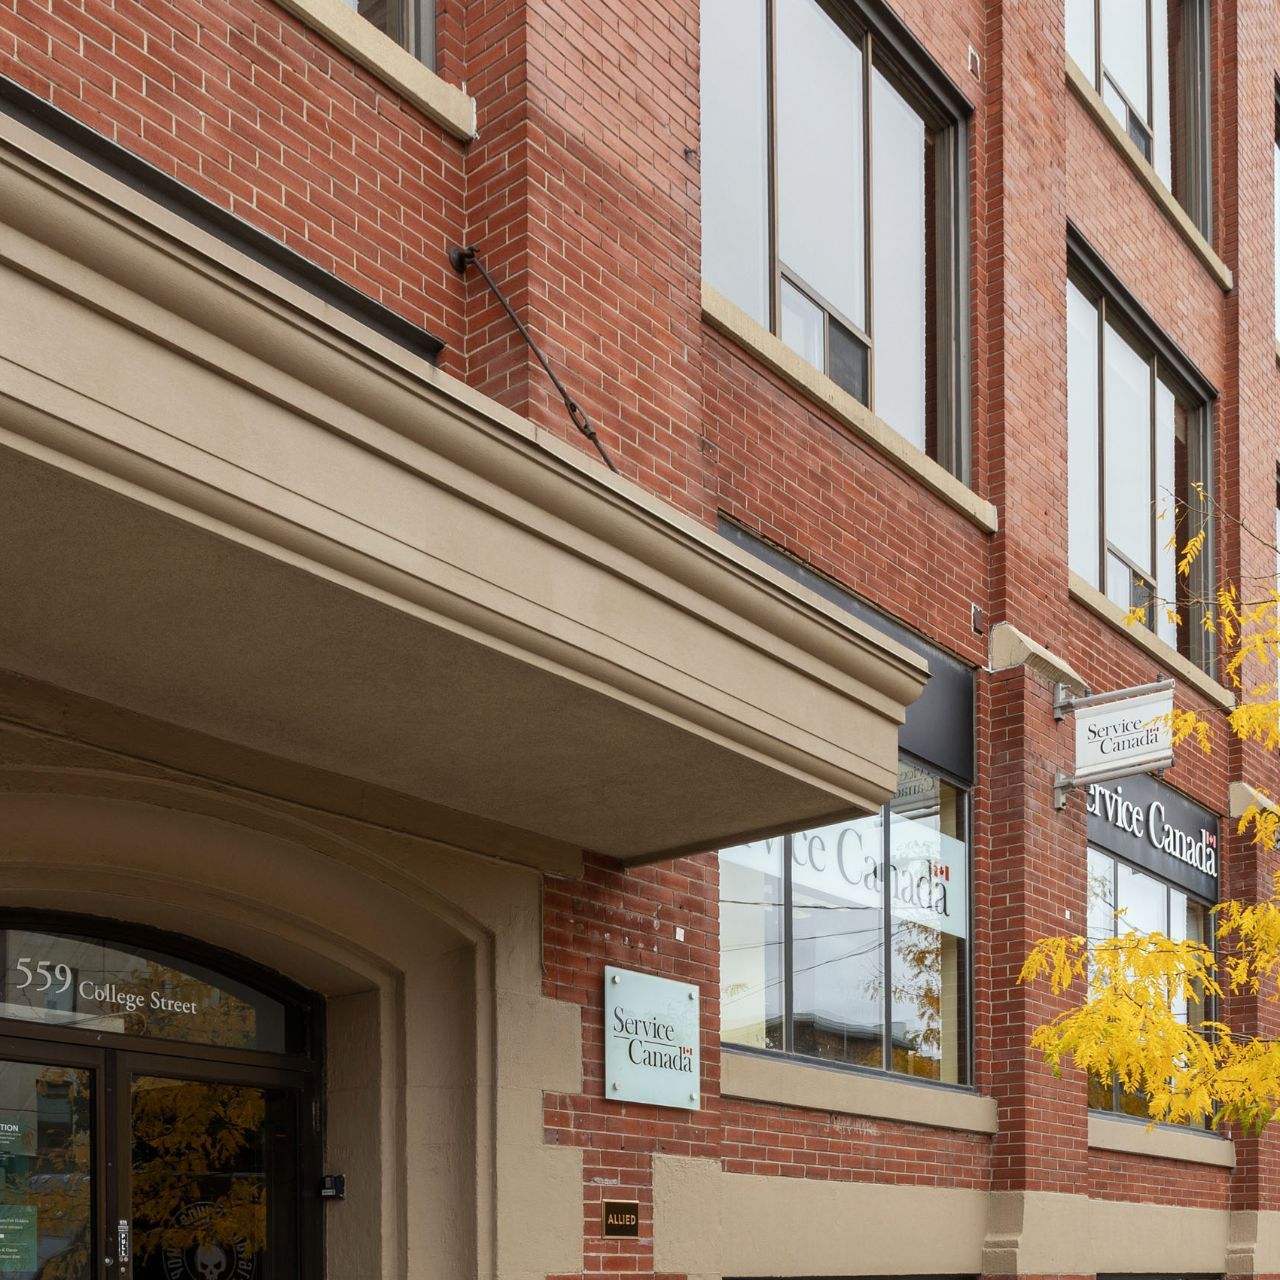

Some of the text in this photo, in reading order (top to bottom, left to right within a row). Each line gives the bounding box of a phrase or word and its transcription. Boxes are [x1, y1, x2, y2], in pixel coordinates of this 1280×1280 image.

[1087, 717, 1143, 742] Service
[1100, 729, 1159, 755] Canada
[1087, 783, 1218, 878] ervice Canada
[836, 828, 951, 918] Canada
[15, 957, 198, 1016] 559 College Street
[613, 1005, 675, 1042] Service
[628, 1038, 694, 1073] Canada
[608, 1213, 637, 1226] ALLIED
